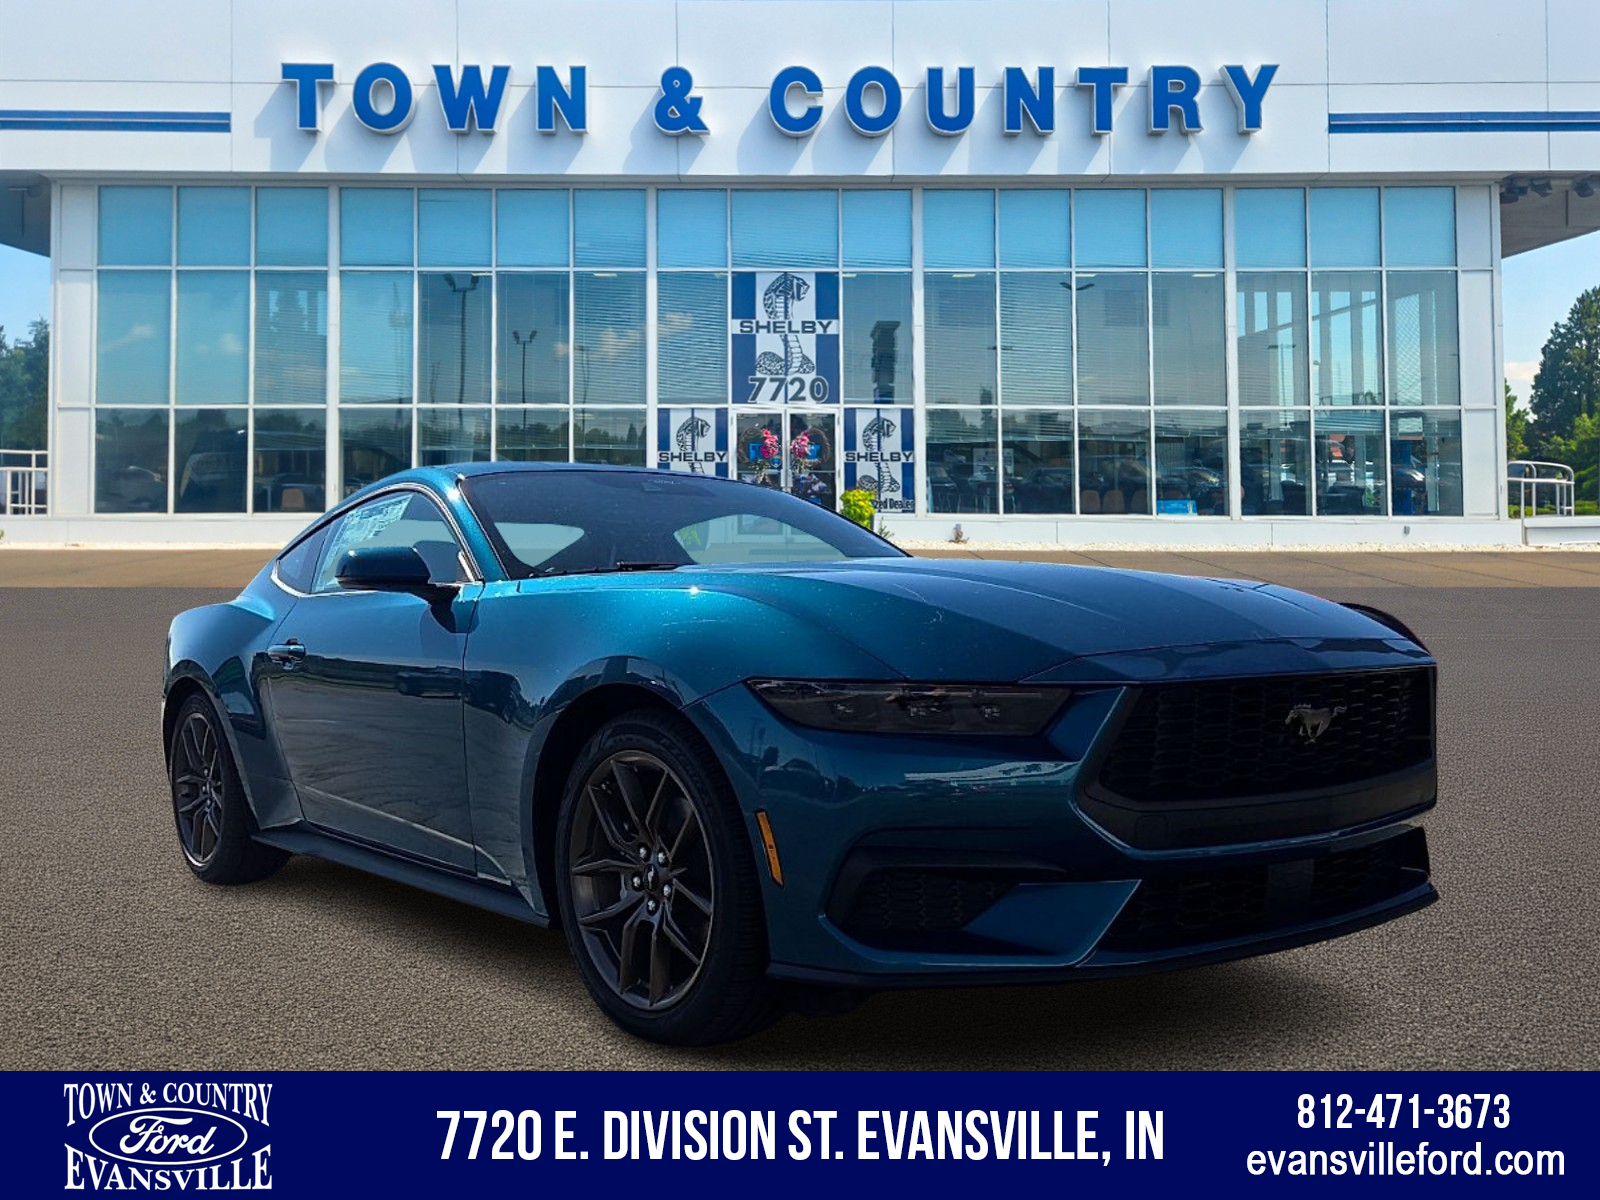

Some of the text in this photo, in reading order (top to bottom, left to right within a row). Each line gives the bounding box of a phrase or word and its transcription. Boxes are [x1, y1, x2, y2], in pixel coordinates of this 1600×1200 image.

[281, 63, 1279, 134] TOWN & COUNTRY
[739, 320, 833, 334] SHELBY
[748, 376, 828, 404] 7720
[658, 451, 728, 463] SHELBY
[845, 451, 914, 463] SHELBY
